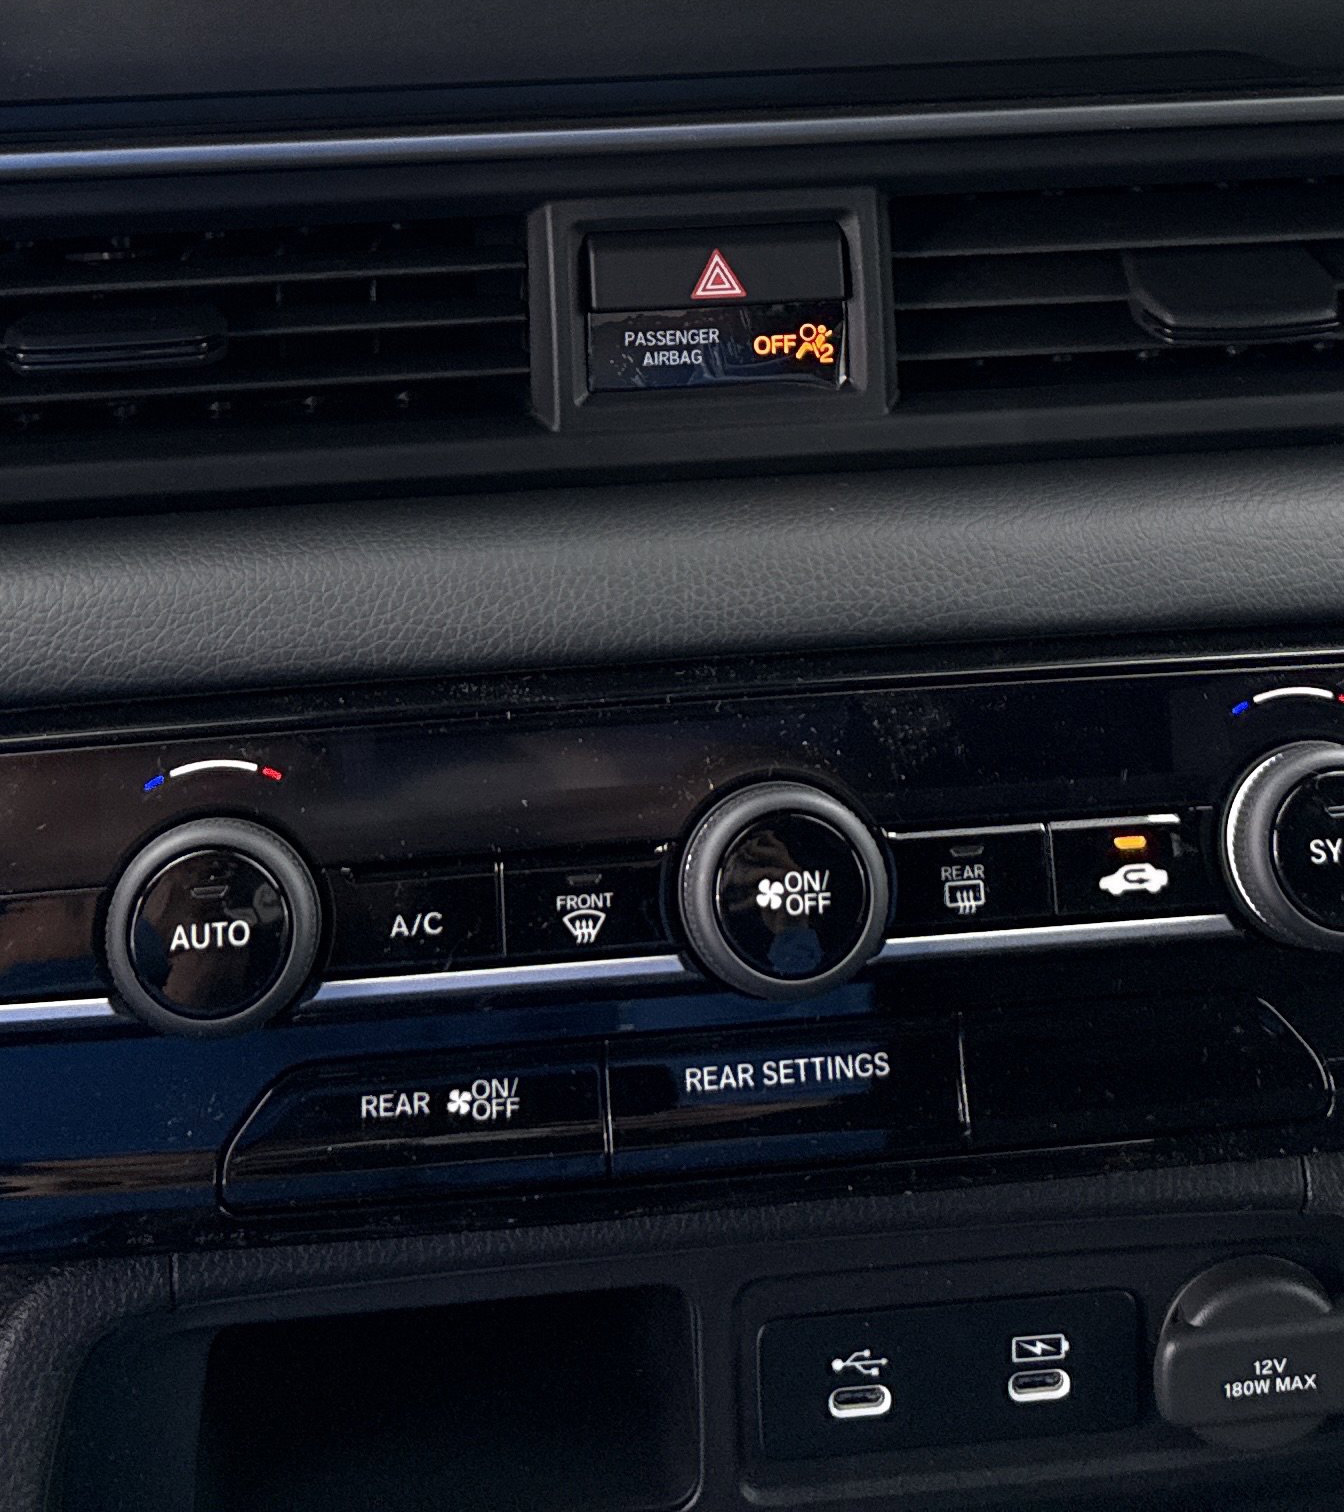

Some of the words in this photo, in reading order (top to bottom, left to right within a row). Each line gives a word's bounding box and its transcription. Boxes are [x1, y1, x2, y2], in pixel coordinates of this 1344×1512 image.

[624, 327, 720, 347] PASSENGER
[753, 333, 797, 356] OFF
[642, 349, 703, 367] AIRBAG
[784, 869, 830, 892] ON/
[941, 863, 985, 881] REAR
[556, 891, 614, 912] FRONT
[785, 891, 832, 917] OFF
[169, 919, 251, 951] AUTO
[390, 911, 443, 938] A/C
[685, 1063, 755, 1092] REAR
[762, 1051, 891, 1086] SETTINGS
[471, 1076, 520, 1098] ON/
[361, 1091, 431, 1118] REAR
[471, 1095, 520, 1121] OFF
[1253, 1357, 1287, 1375] 12V
[1224, 1378, 1271, 1399] 180W
[1275, 1373, 1317, 1393] MAX
